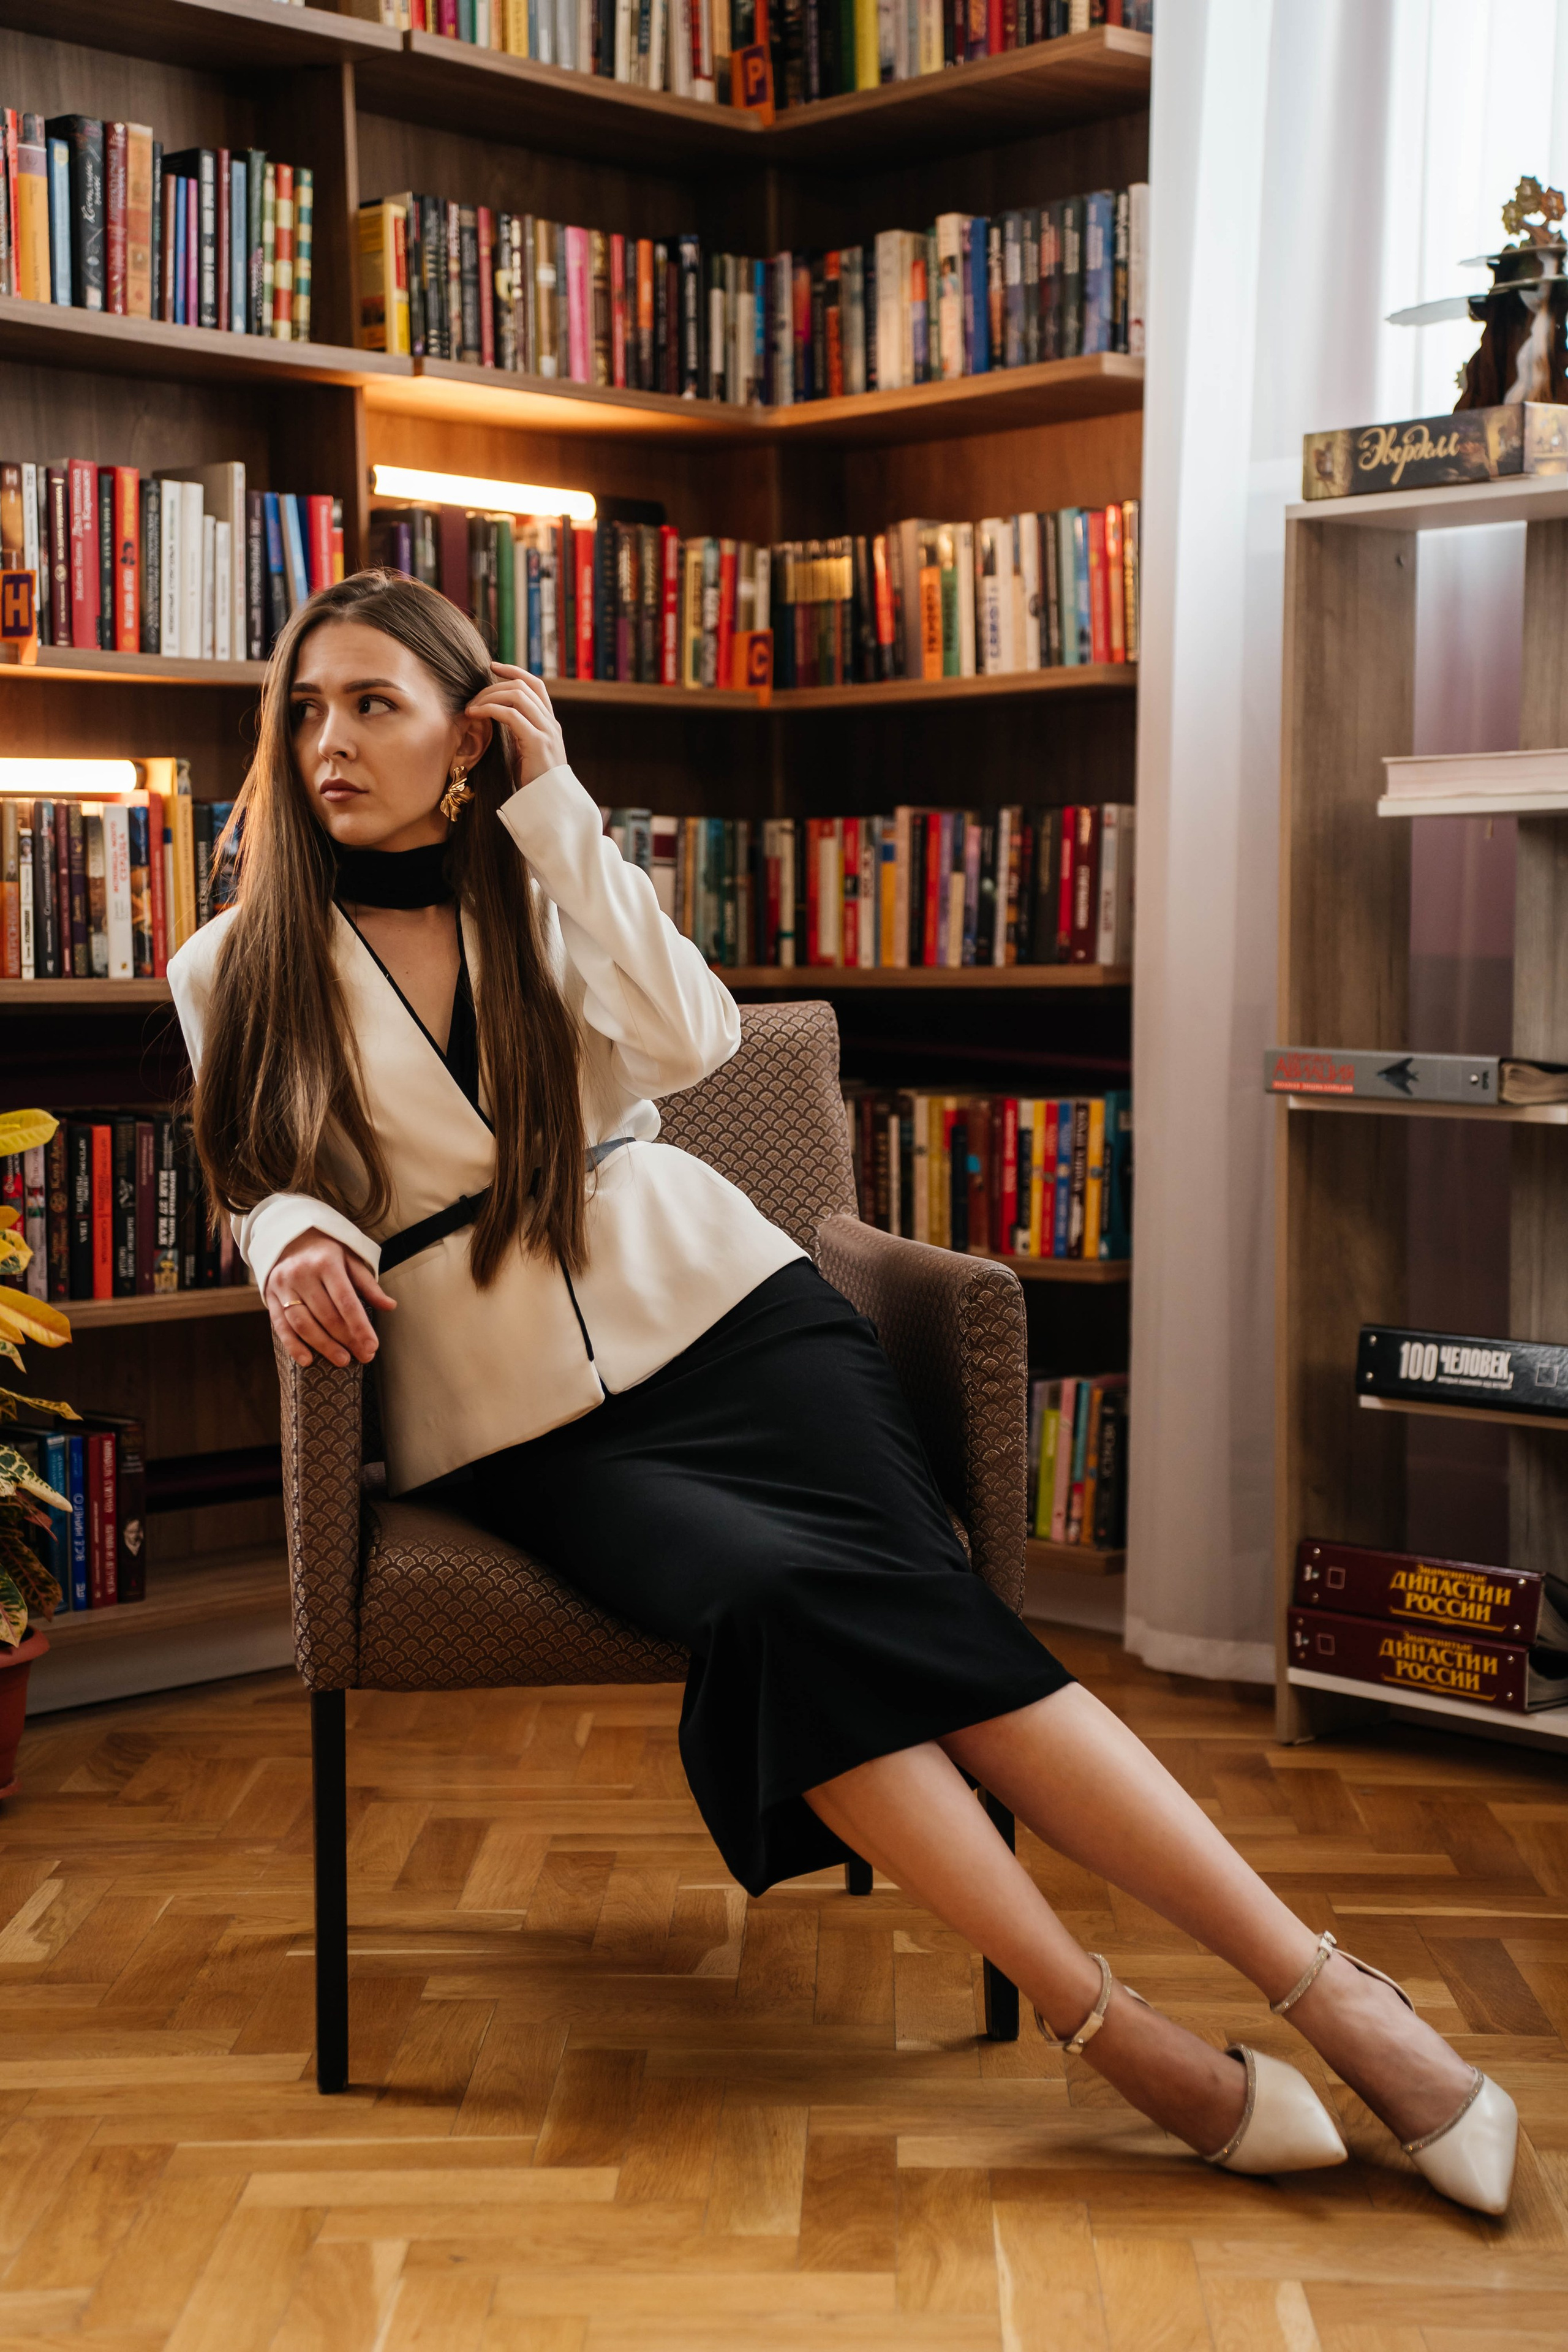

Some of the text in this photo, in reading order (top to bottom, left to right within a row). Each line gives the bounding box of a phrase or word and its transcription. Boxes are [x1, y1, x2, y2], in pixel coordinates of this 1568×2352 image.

[1272, 1056, 1355, 1083] АВИАЦИЯ
[1400, 1342, 1438, 1381] 100
[1390, 1570, 1512, 1607] ДИНАСТИИ
[1405, 1592, 1491, 1623] РОССИИ
[1379, 1638, 1498, 1676] ДИНАСТИИ
[1396, 1659, 1480, 1692] РОССИИ
